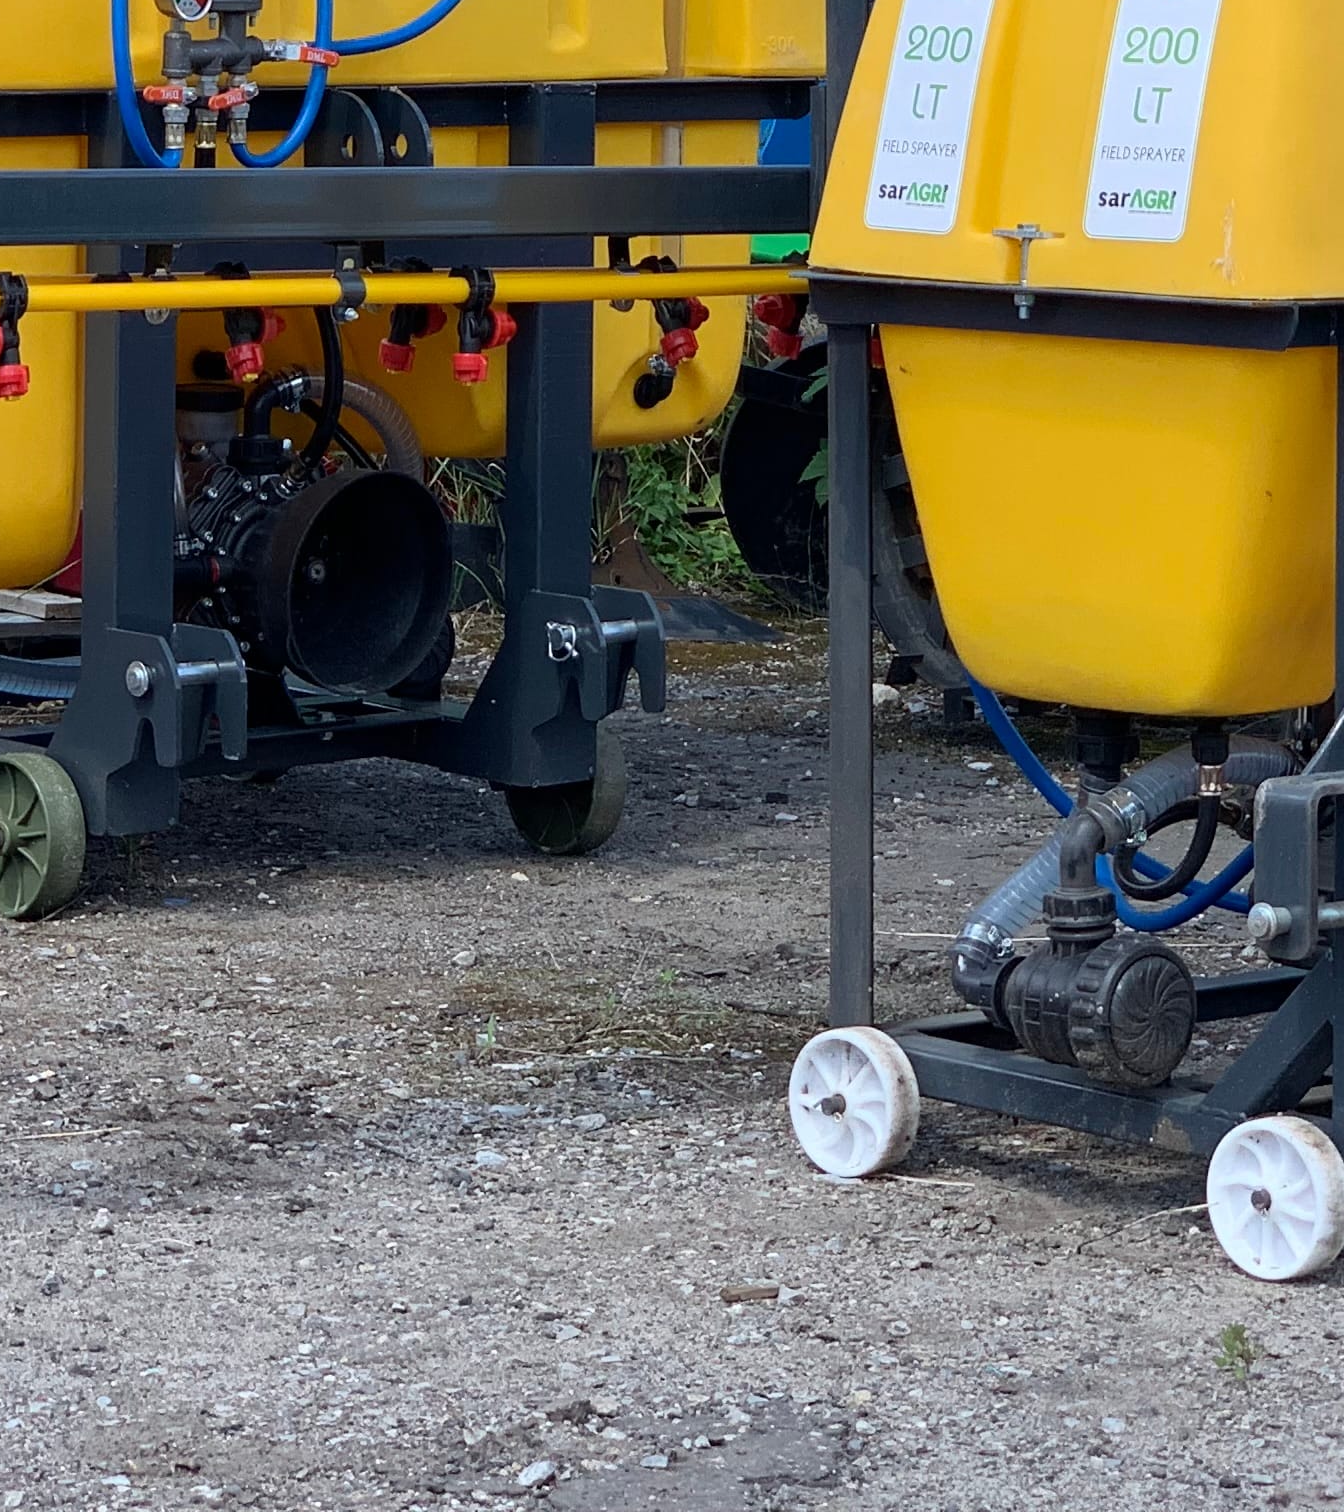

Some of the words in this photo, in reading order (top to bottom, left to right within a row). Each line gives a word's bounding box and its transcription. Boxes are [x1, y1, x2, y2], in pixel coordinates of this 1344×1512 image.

[904, 24, 974, 63] 200
[1122, 26, 1200, 65] 200
[912, 83, 948, 120] LT
[1132, 86, 1173, 124] LT
[882, 139, 909, 153] FIELD
[910, 140, 958, 157] SPRAYER
[1100, 145, 1131, 161] FIELD
[1133, 146, 1186, 162] SPRAYER
